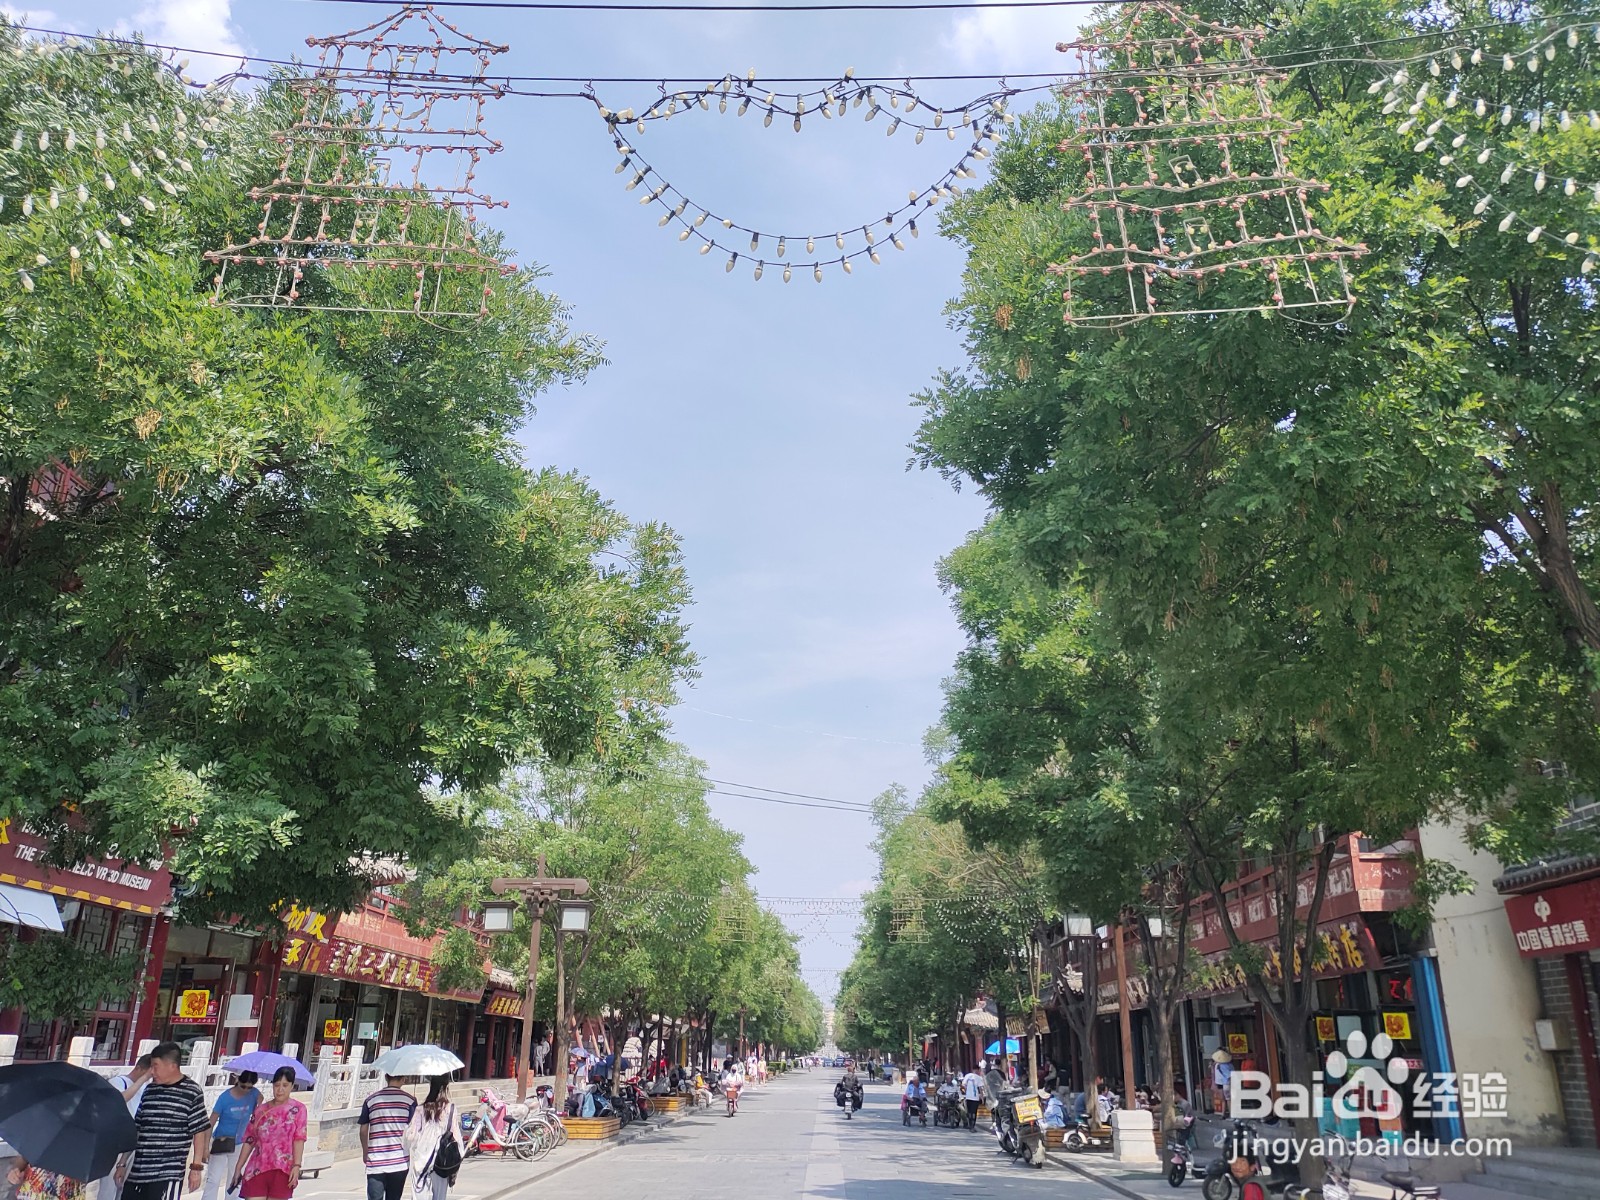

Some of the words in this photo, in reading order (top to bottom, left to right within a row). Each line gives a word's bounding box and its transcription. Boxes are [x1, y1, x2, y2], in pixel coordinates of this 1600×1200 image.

[15, 844, 38, 862] THE
[95, 866, 109, 881] VR
[107, 869, 120, 884] 3D
[119, 872, 152, 891] MUSEUM
[1516, 919, 1591, 952] 中国福利彩票
